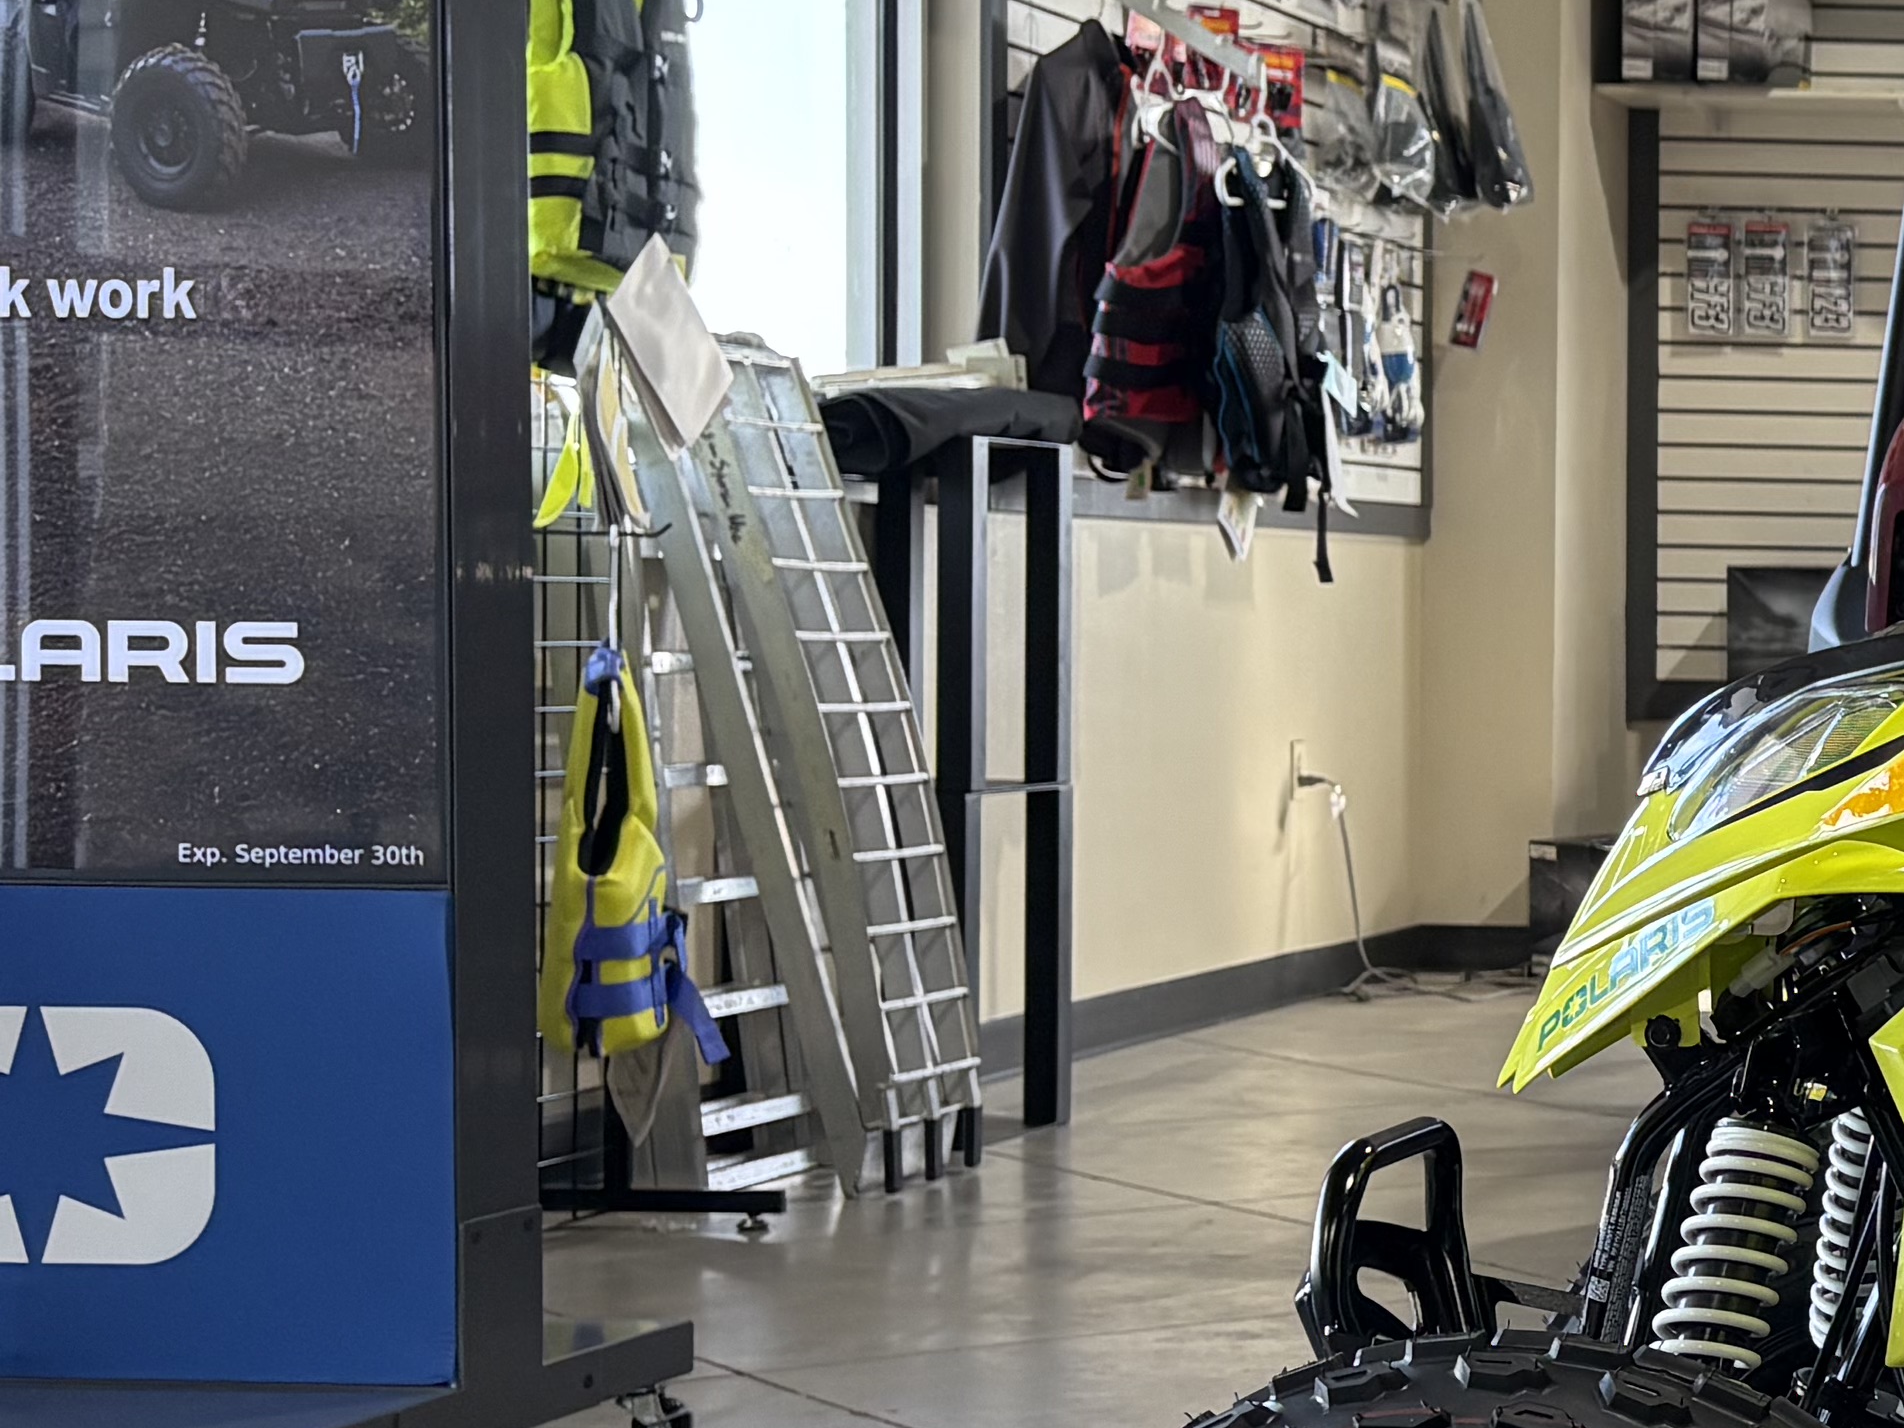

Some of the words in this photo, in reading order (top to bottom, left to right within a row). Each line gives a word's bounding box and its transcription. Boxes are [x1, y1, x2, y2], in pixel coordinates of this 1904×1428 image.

[46, 265, 197, 319] work
[0, 619, 305, 684] ARIS
[177, 843, 228, 868] Exp.
[235, 841, 364, 868] September
[370, 843, 424, 867] 30th
[1537, 899, 1716, 1054] POLARIS
